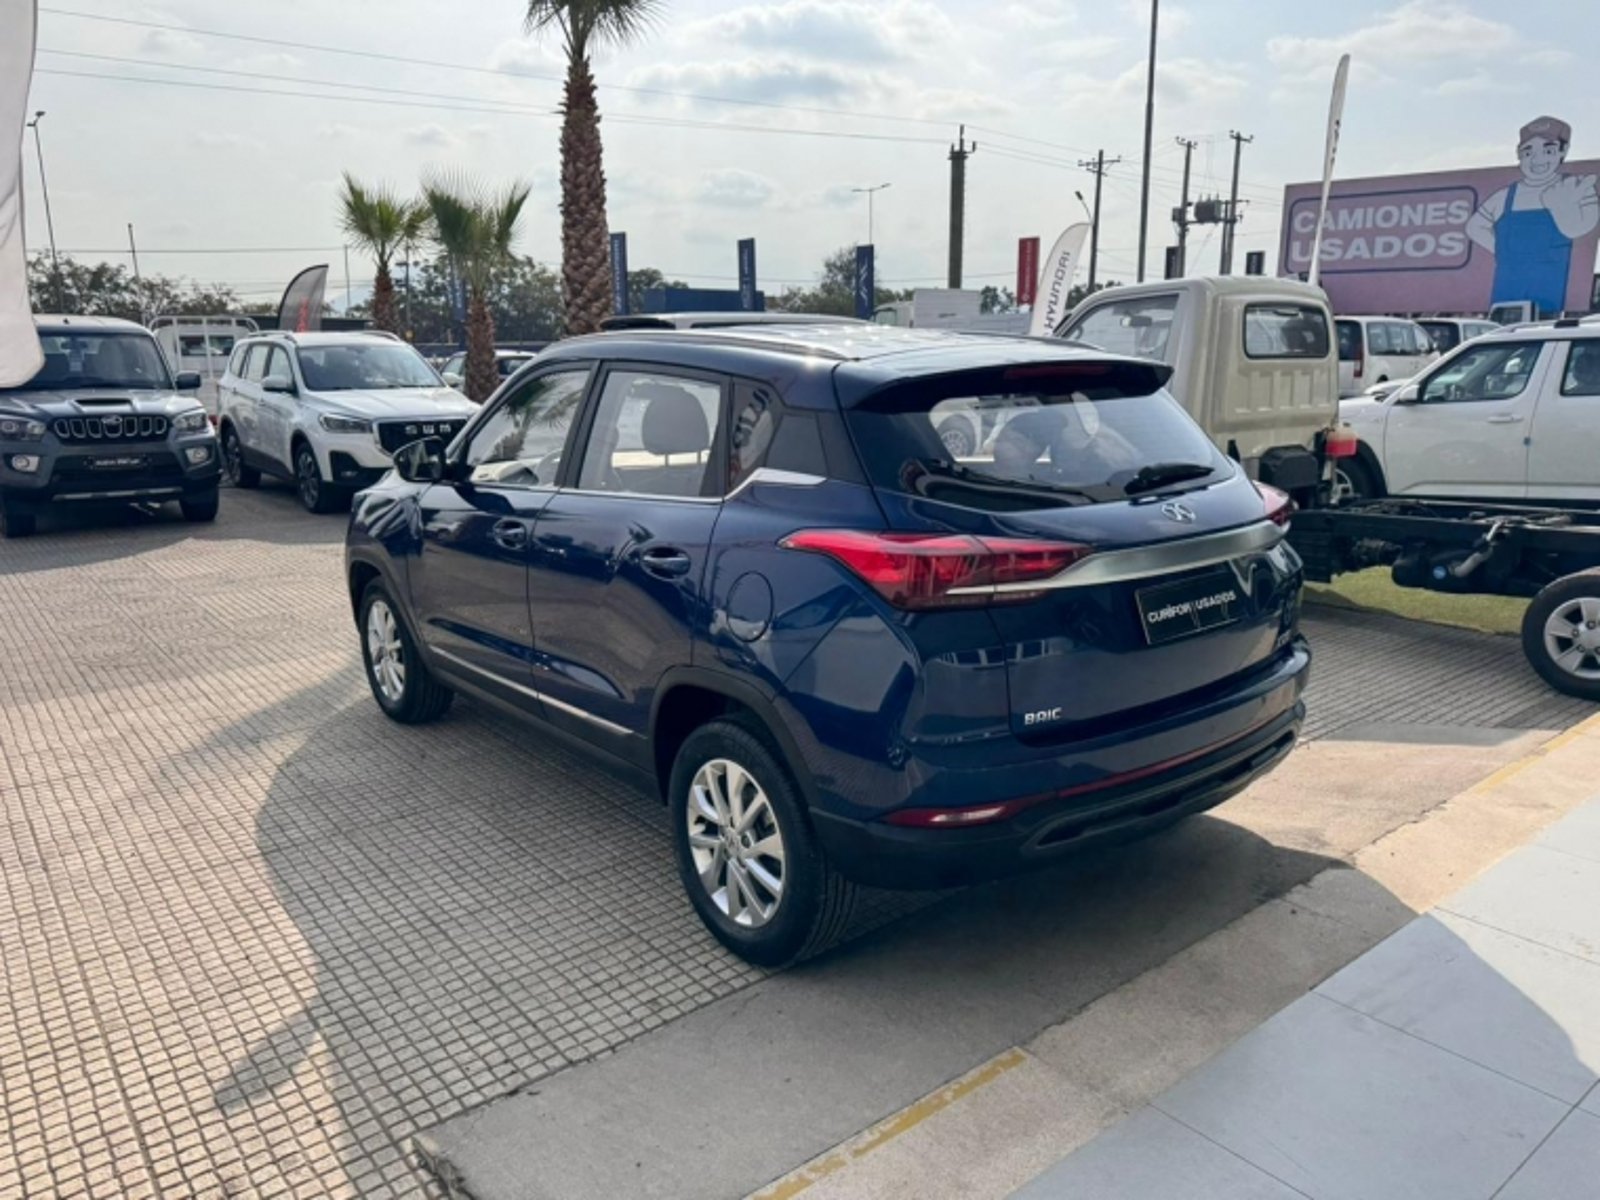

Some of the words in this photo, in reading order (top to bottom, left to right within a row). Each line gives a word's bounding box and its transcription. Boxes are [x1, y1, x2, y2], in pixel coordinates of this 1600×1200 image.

[1293, 200, 1470, 233] CAMIONES
[1291, 231, 1466, 262] USADOS
[1044, 250, 1070, 329] HYUNDAI
[1196, 590, 1236, 609] USADOS
